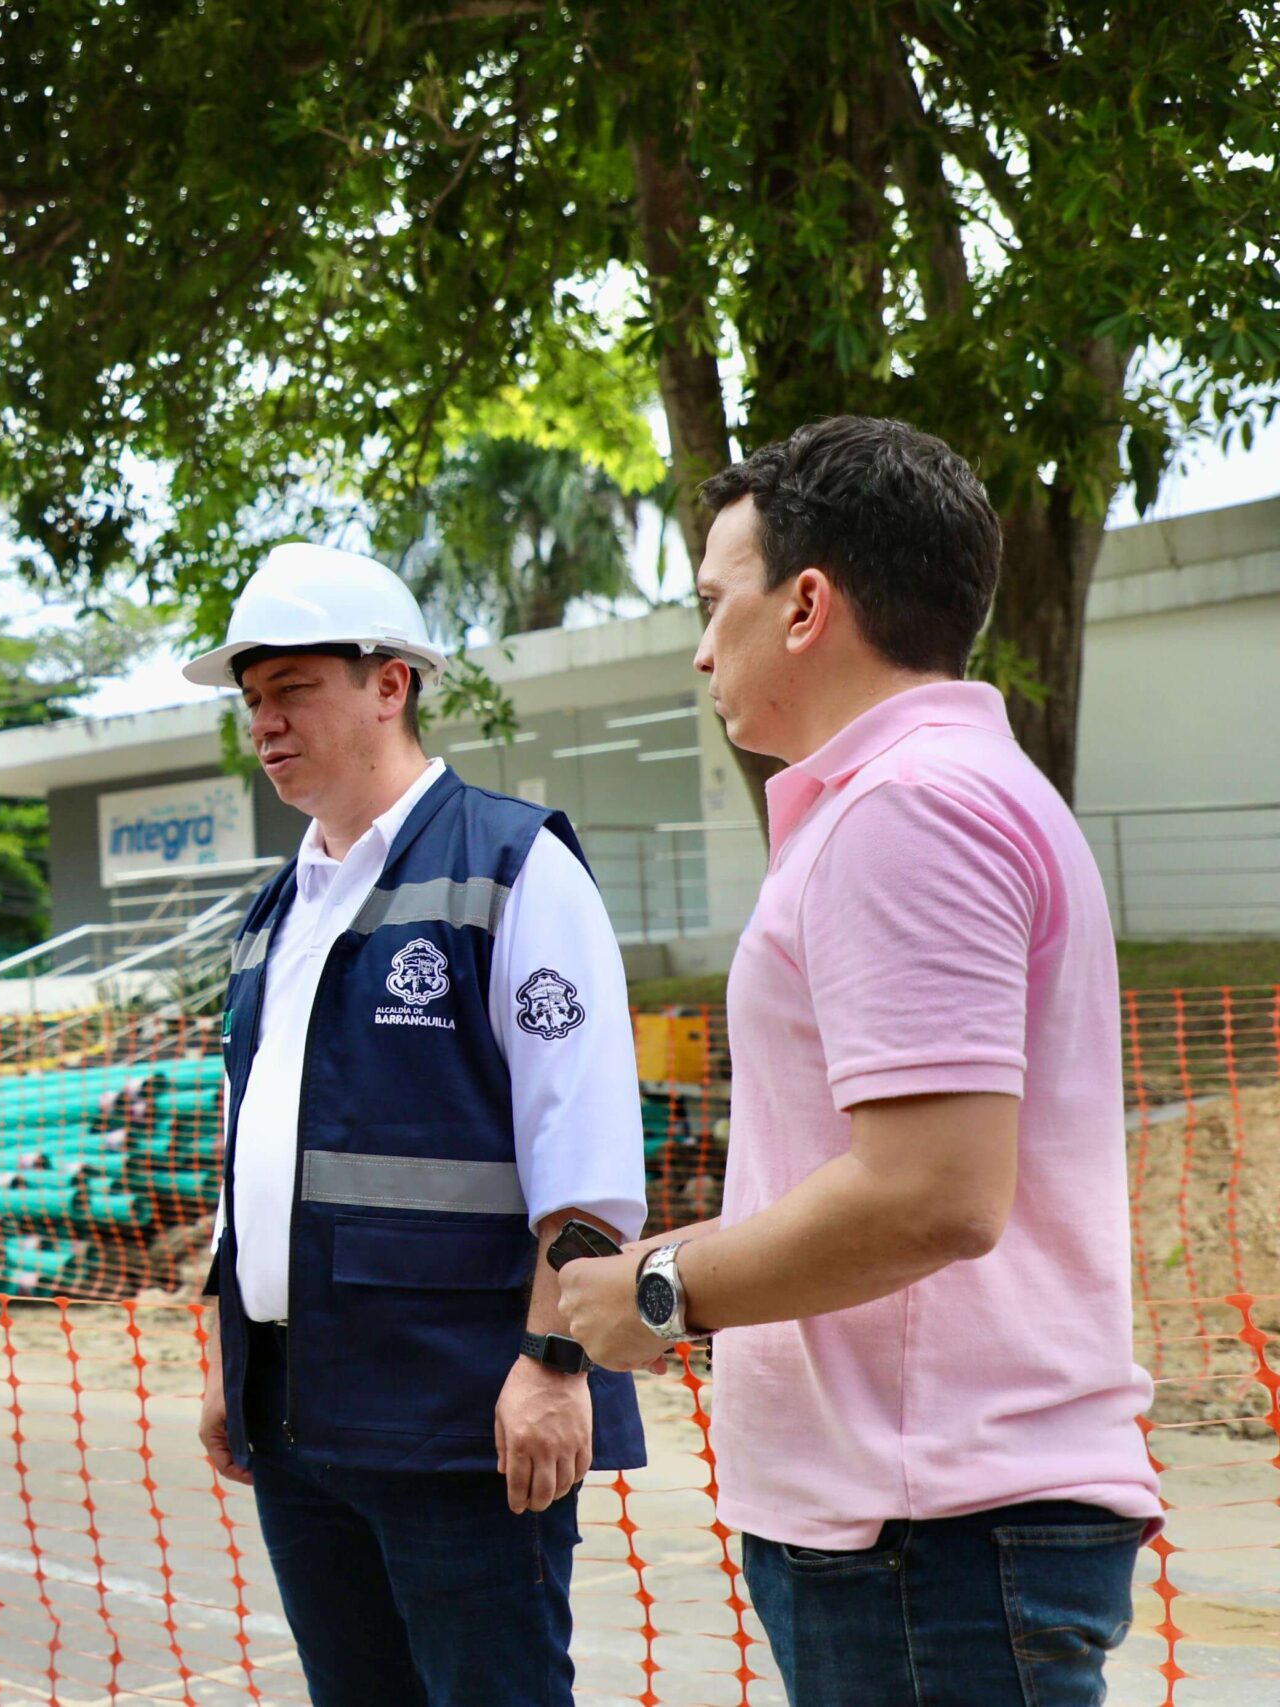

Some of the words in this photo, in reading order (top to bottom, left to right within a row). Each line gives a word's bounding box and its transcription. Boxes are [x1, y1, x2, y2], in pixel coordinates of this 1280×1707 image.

[110, 815, 213, 861] integra
[376, 1005, 411, 1014] ALCALDÍA
[413, 1007, 424, 1015] DE
[375, 1014, 456, 1030] BARRANQUILLA
